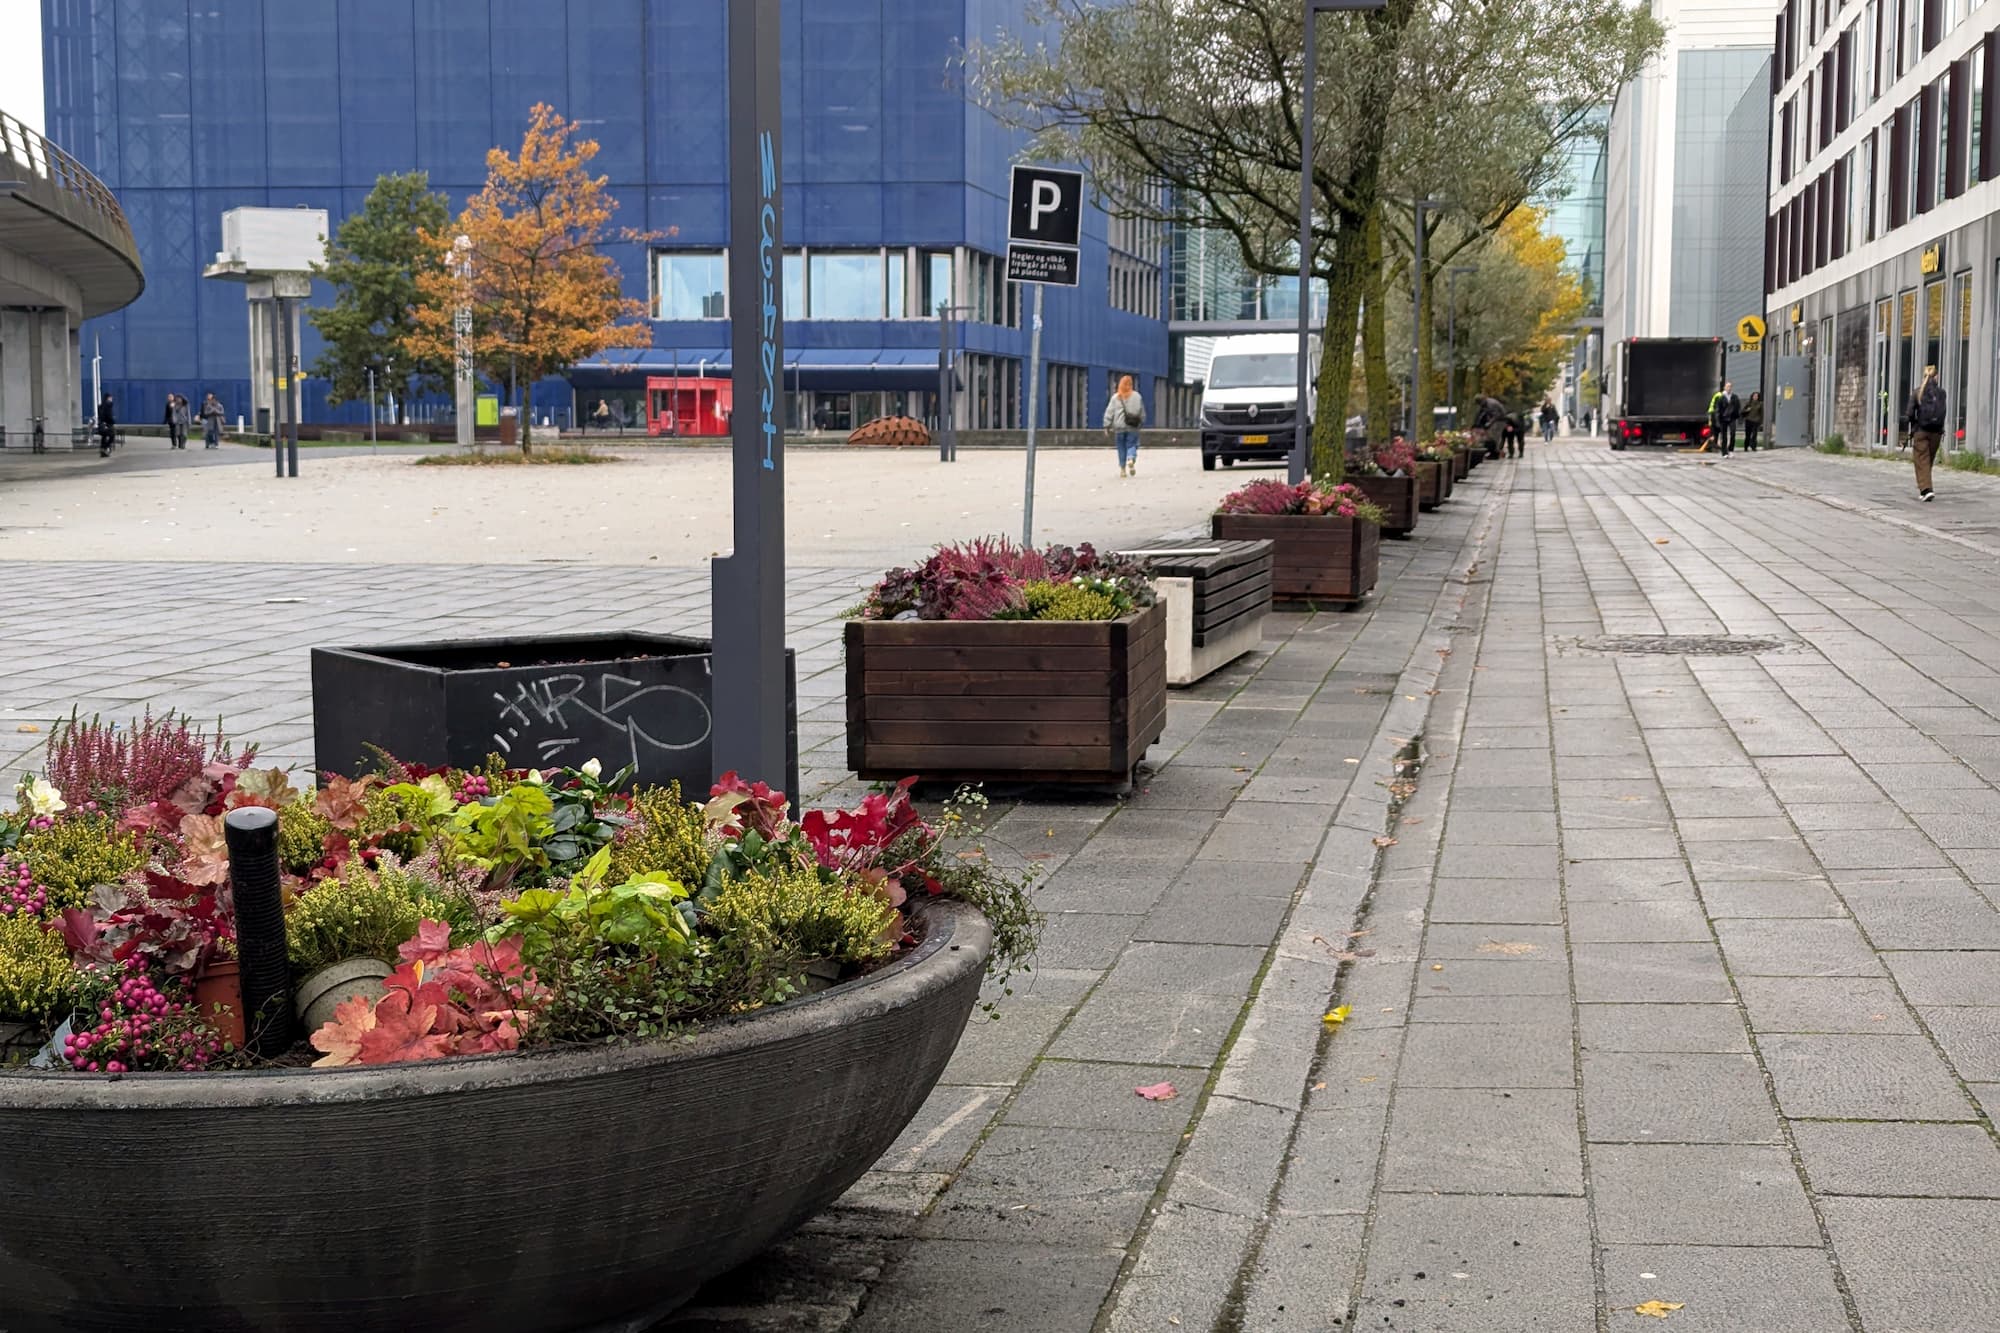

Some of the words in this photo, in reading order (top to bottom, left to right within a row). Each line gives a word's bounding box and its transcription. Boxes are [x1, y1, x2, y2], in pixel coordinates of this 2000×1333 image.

[1029, 179, 1062, 231] P
[1011, 252, 1034, 261] Regler
[1011, 260, 1039, 269] fremgår
[1010, 267, 1020, 276] på
[1020, 268, 1048, 277] pladsen
